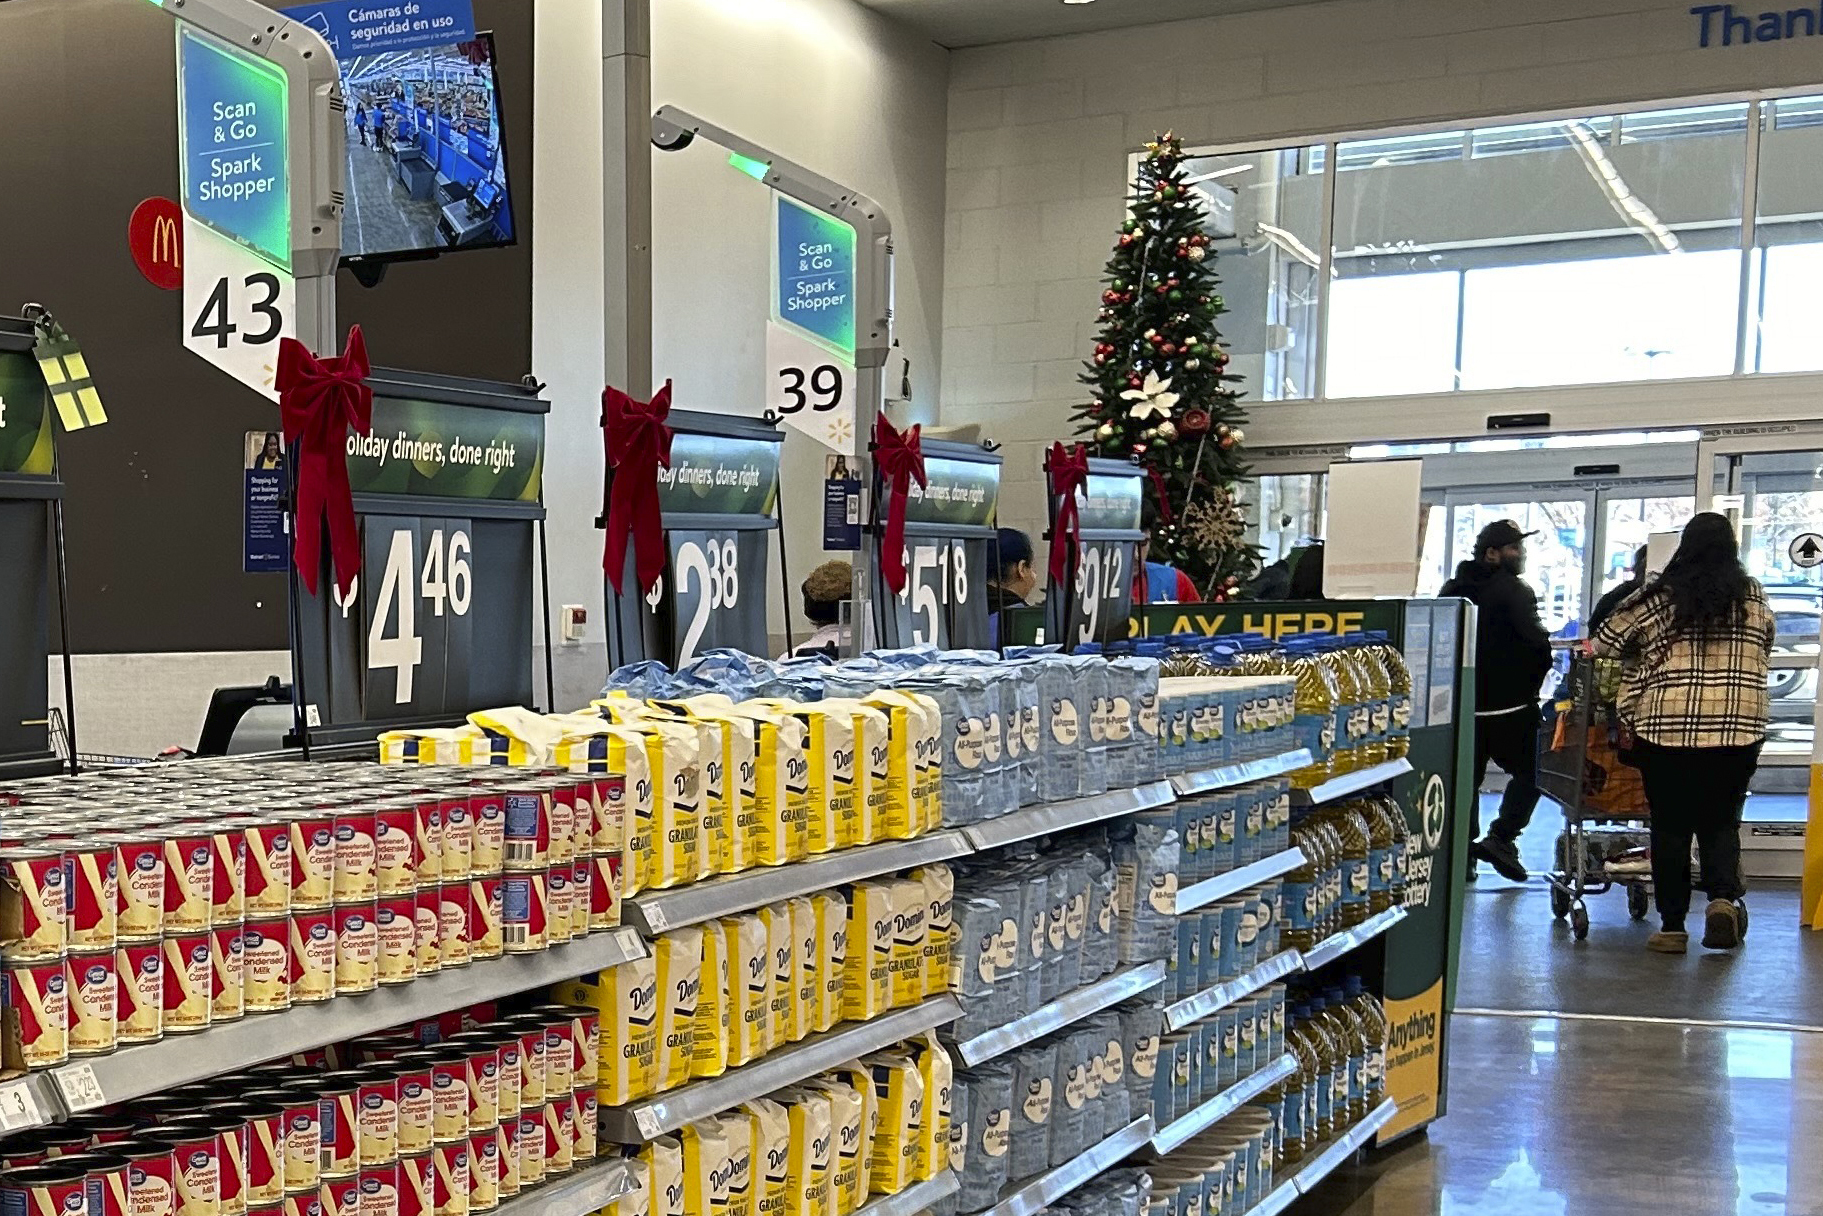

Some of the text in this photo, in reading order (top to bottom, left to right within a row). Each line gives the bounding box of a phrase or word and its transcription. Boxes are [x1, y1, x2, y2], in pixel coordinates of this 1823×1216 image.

[348, 1, 420, 23] Cámaras de
[350, 18, 411, 41] seguridad
[413, 20, 429, 31] en
[432, 15, 454, 28] uso
[1690, 0, 1823, 47] Than
[212, 100, 256, 122] Scan
[213, 121, 257, 143] & Go
[211, 153, 262, 182] Spark
[199, 176, 276, 203] Shopper
[798, 241, 833, 257] Scan
[799, 256, 833, 270] & Go
[796, 278, 836, 298] Spark
[191, 272, 282, 348] 43
[787, 293, 846, 312] Shopper
[777, 364, 843, 415] 39
[346, 428, 516, 475] oliday dinners, done right
[679, 460, 713, 489] dinners,
[715, 462, 737, 486] done
[738, 464, 760, 493] right
[346, 858, 362, 867] Milk
[379, 852, 396, 861] Milk
[244, 956, 284, 966] ondensed
[253, 965, 271, 975] Milk
[902, 969, 919, 980] SUGAR
[1387, 1009, 1436, 1050] Anything
[136, 1203, 155, 1214] Milk
